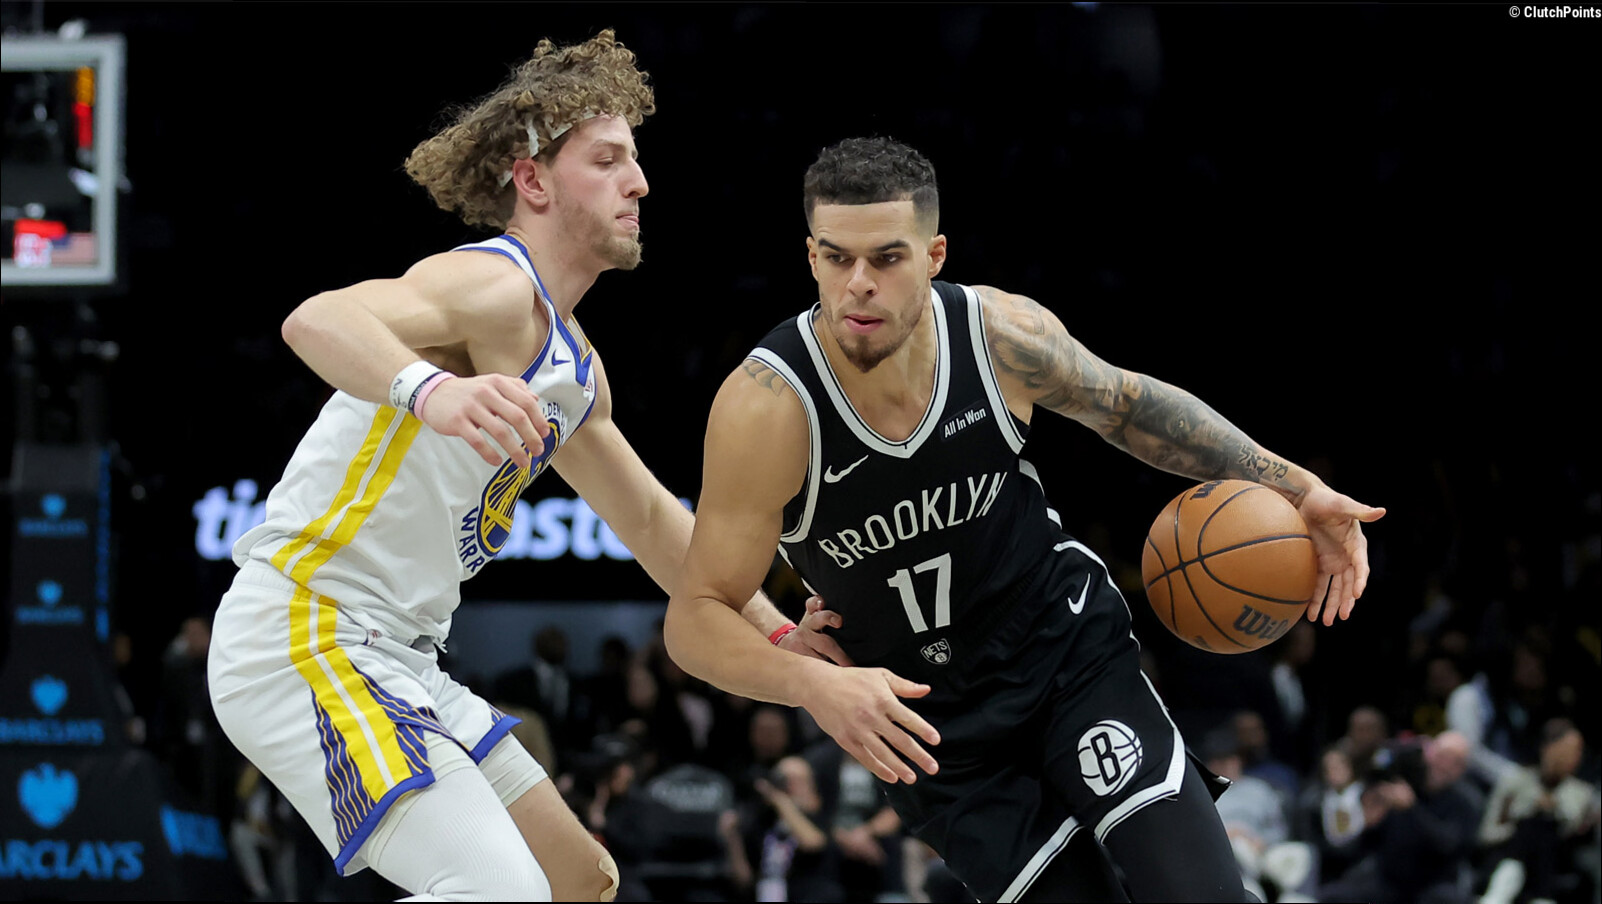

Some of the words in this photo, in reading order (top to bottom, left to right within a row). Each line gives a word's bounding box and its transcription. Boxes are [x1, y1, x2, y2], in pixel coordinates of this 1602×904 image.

[944, 420, 957, 438] All
[955, 417, 967, 431] In
[964, 408, 987, 425] Won
[459, 505, 486, 573] WARR
[817, 471, 1008, 569] BROOKLYN
[887, 552, 952, 634] 17
[923, 641, 948, 659] NETS
[1090, 731, 1122, 787] B
